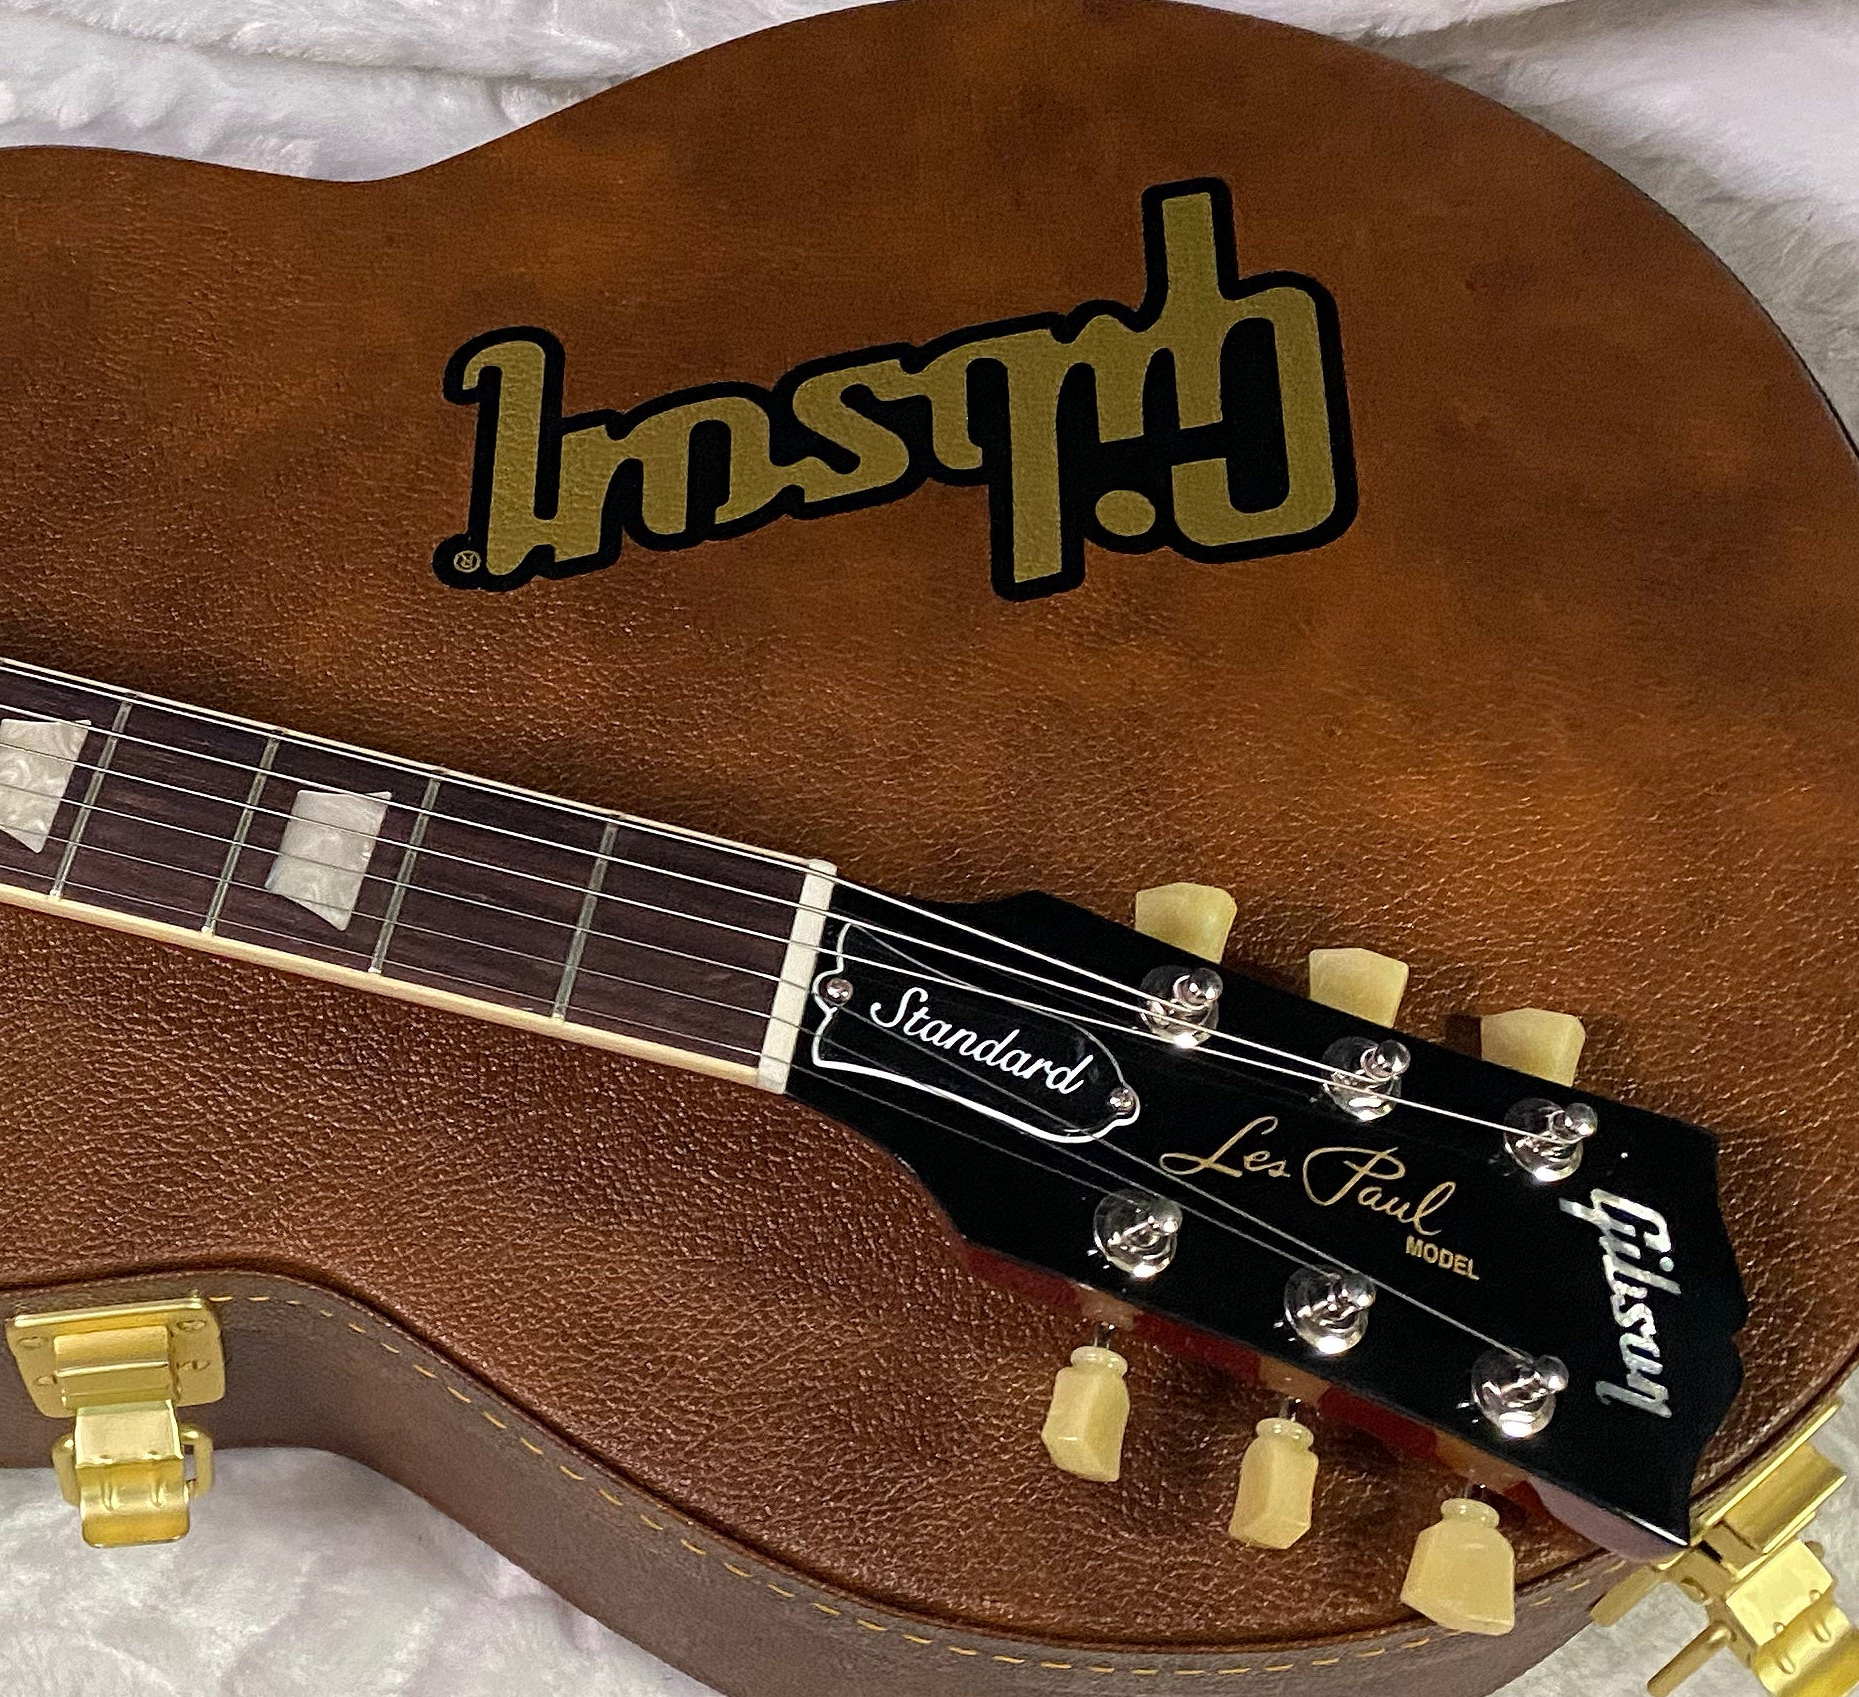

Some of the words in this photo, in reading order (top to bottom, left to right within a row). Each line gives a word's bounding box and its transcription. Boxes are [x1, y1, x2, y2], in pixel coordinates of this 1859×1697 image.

[869, 987, 1094, 1095] Standard
[1159, 1115, 1291, 1178] Les
[1302, 1146, 1457, 1236] Paul
[1405, 1235, 1480, 1280] MODEL
[1558, 1187, 1682, 1418] Gibson
